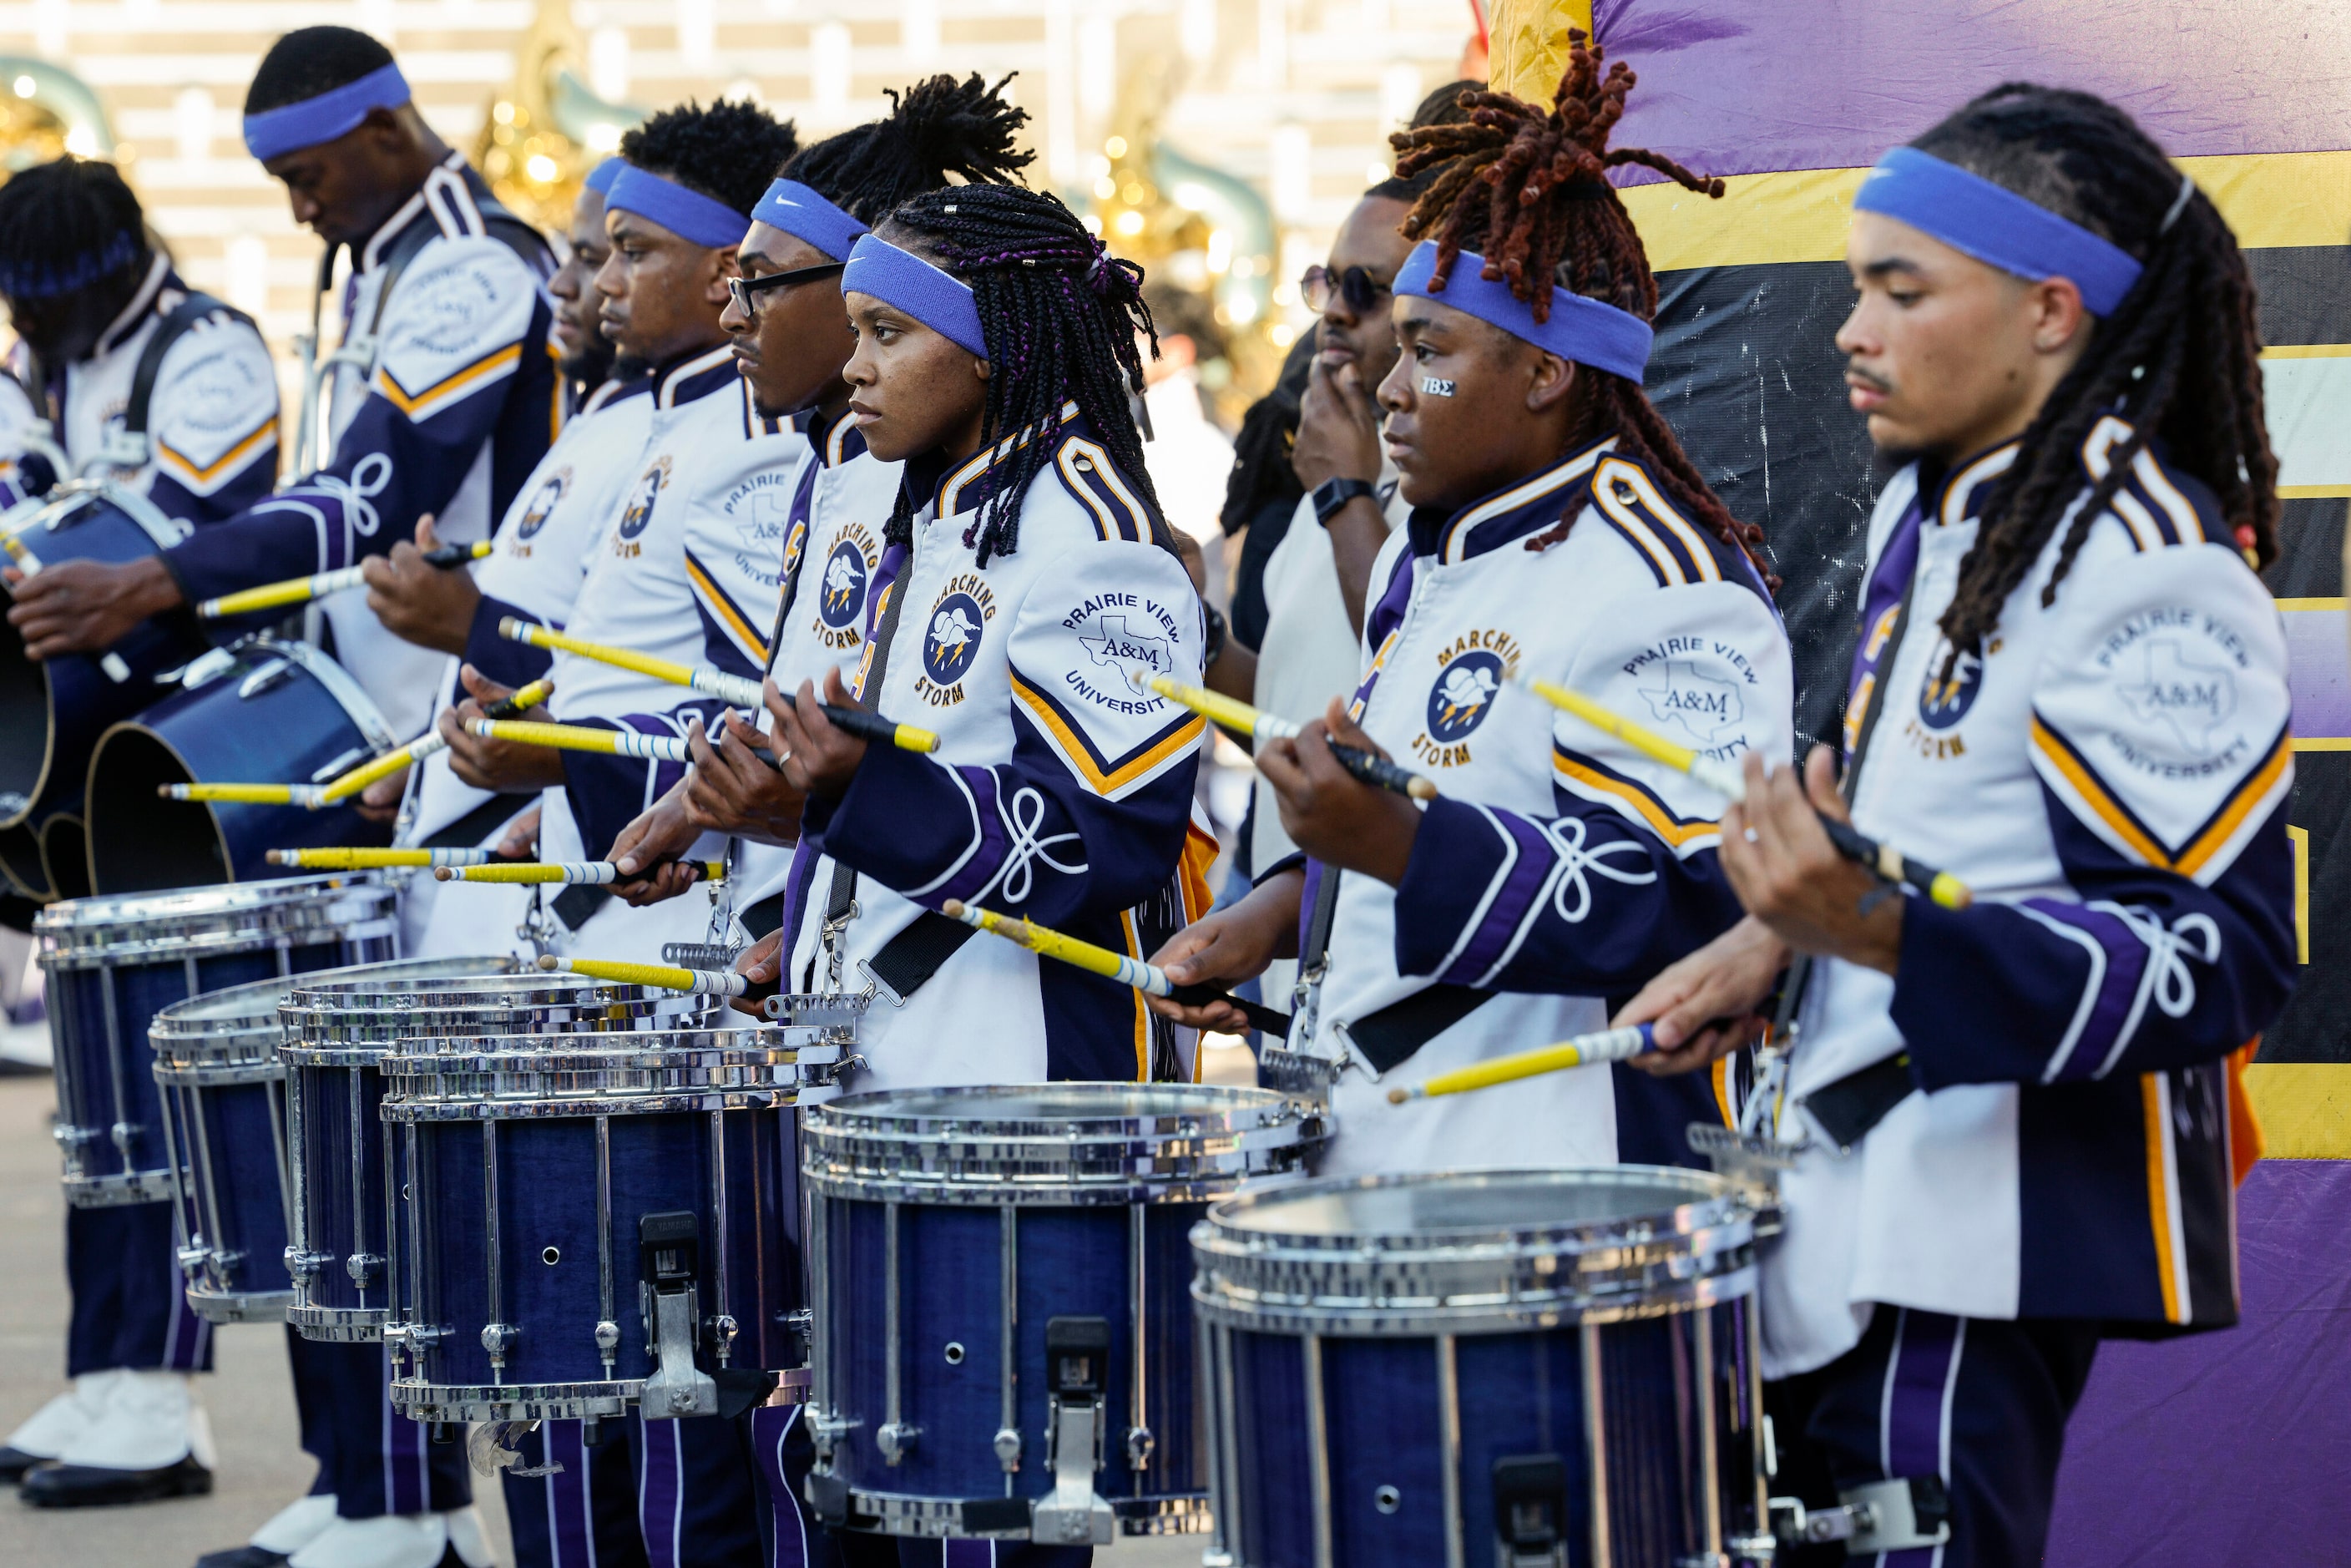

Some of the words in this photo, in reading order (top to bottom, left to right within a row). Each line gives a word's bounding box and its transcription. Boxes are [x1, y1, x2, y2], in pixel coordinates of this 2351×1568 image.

[724, 473, 786, 515] PRAIRIE
[753, 521, 785, 539] A&
[827, 522, 878, 570] MARCHING
[735, 552, 780, 587] UNIVE
[931, 574, 997, 623] MARCHING
[812, 617, 862, 650] STORM
[1062, 593, 1138, 630] PRAIRIE
[1146, 599, 1180, 644] VIEW
[2097, 607, 2195, 668] PRAIRIE
[2204, 615, 2250, 669] VIEW
[1101, 638, 1159, 665] A&M
[1437, 629, 1523, 668] MARCHIN
[1623, 636, 1704, 676] PRAIRIE
[1714, 640, 1759, 686] VIEW
[914, 675, 967, 708] STORM
[1065, 670, 1165, 716] UNIVERSIT
[1664, 689, 1728, 714] A&M
[2147, 681, 2219, 716] A&M
[1411, 733, 1472, 768] STORM
[2109, 731, 2248, 779] UNIVERSITY
